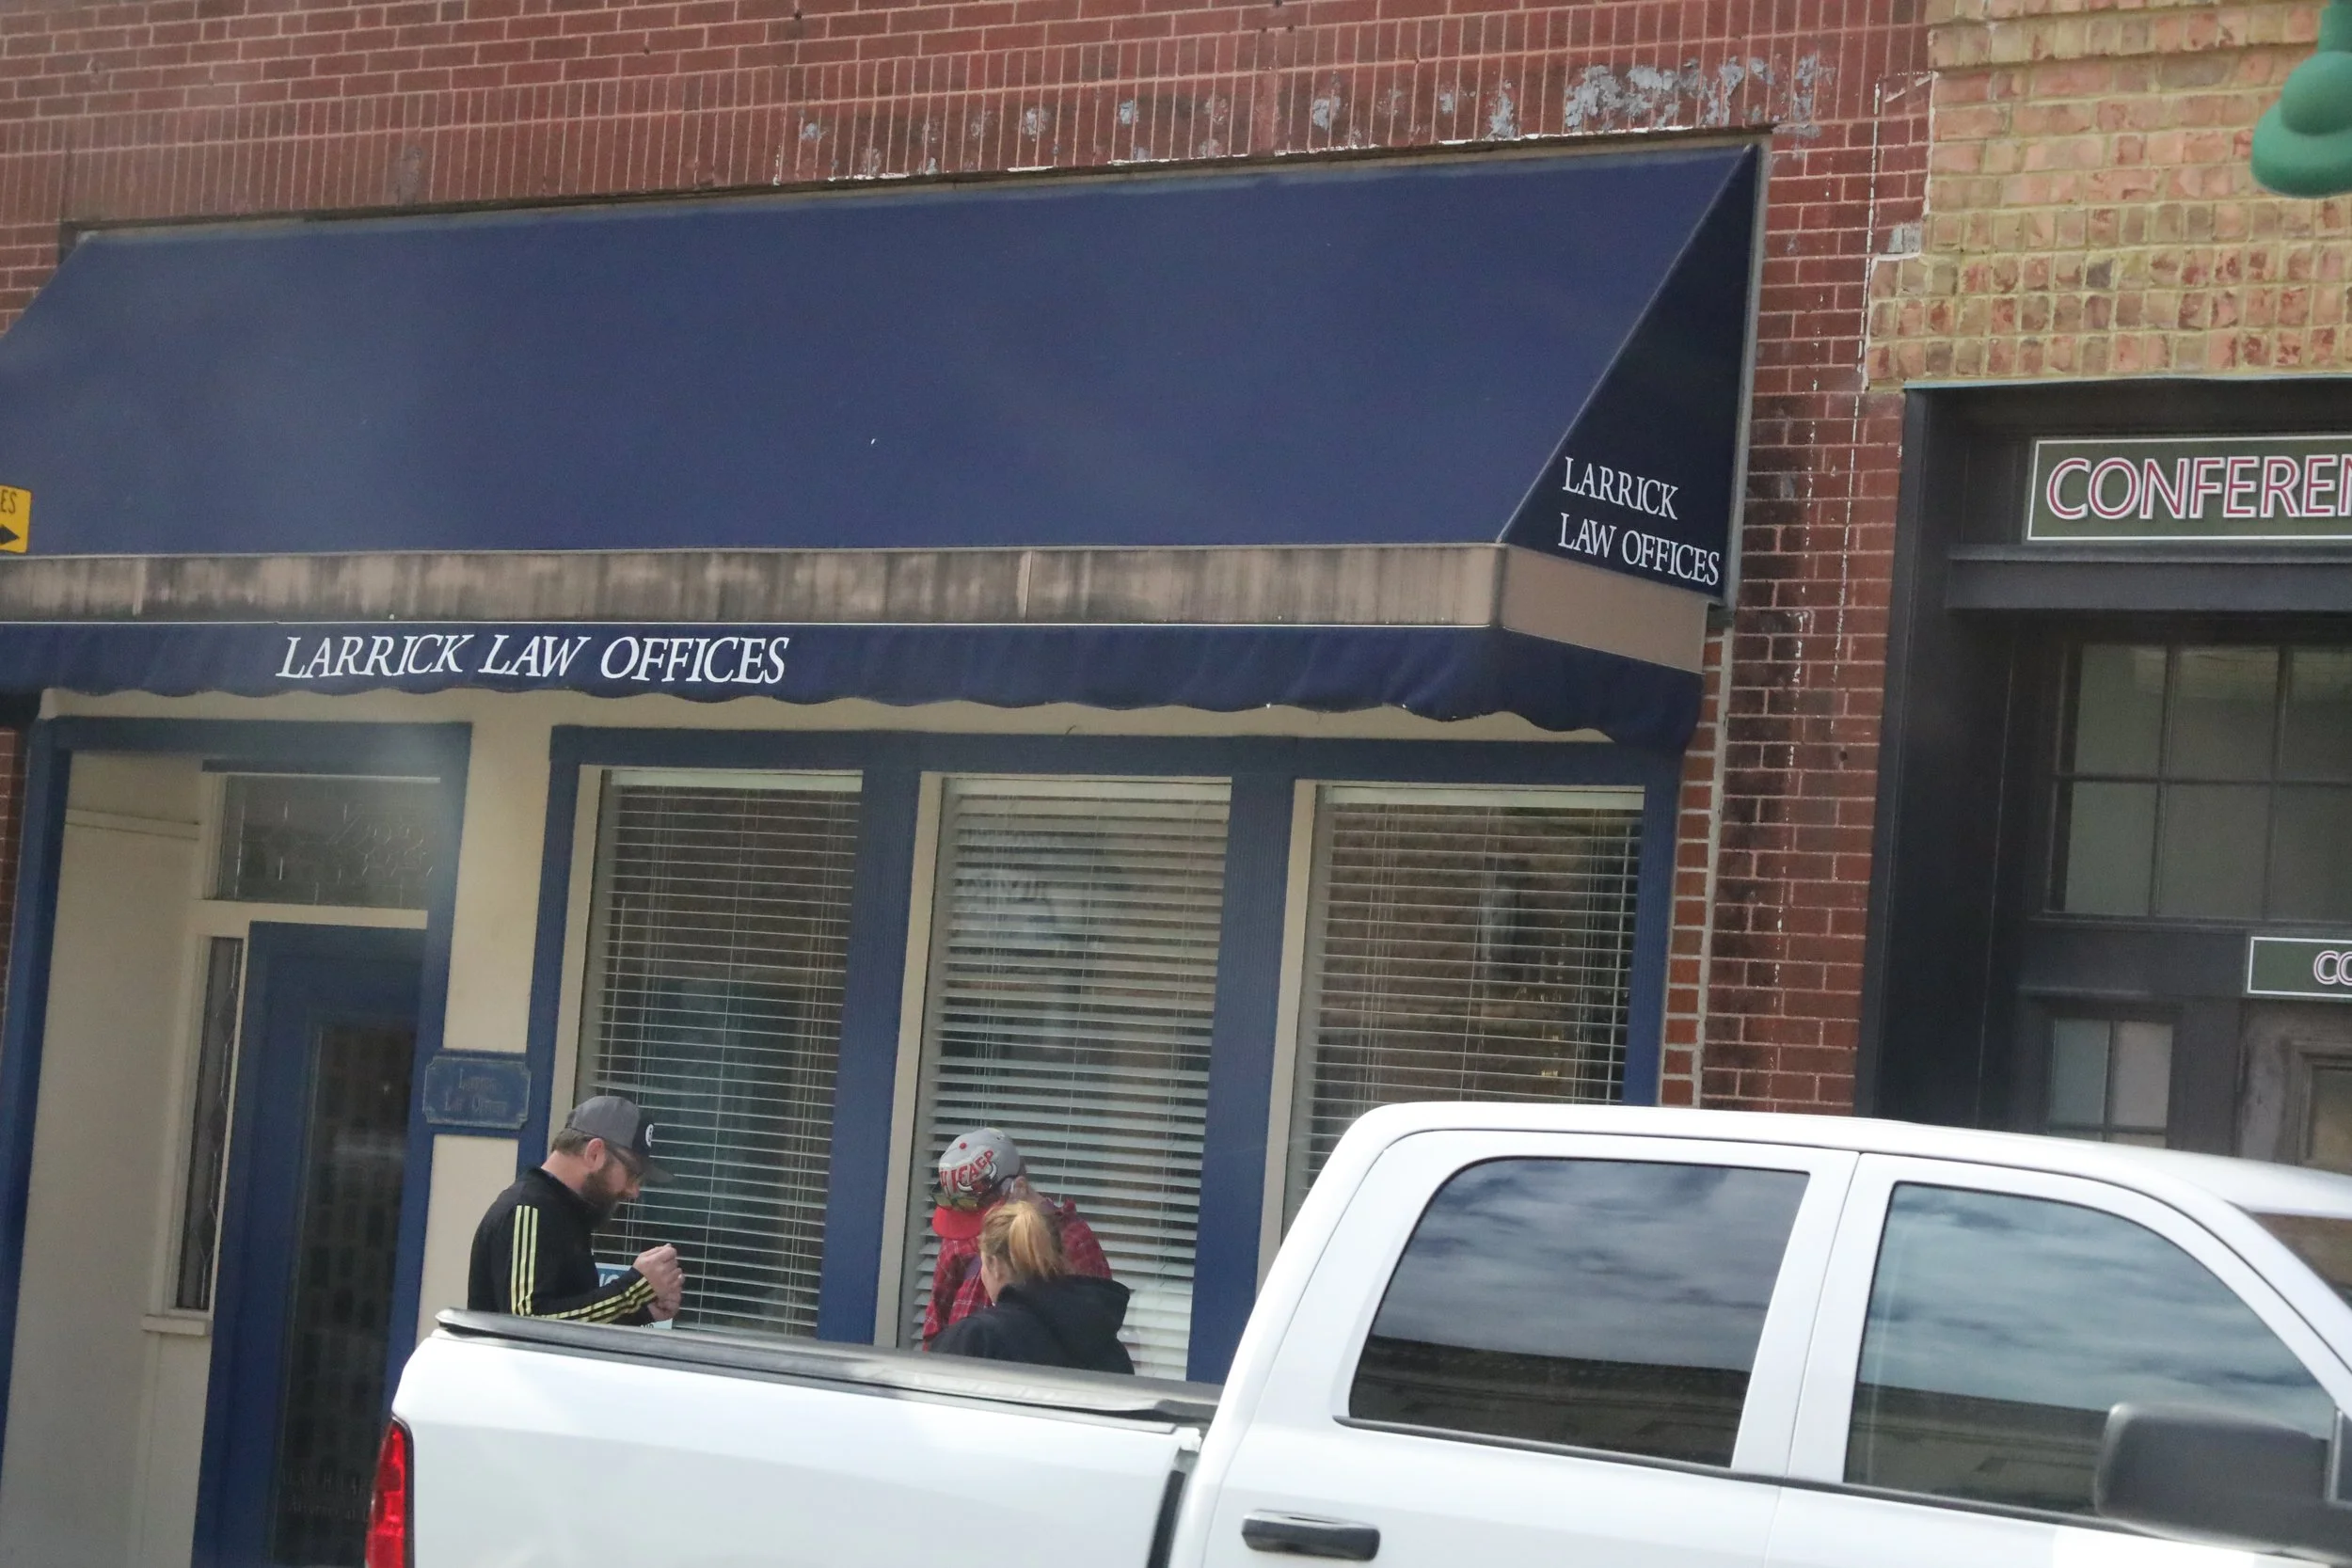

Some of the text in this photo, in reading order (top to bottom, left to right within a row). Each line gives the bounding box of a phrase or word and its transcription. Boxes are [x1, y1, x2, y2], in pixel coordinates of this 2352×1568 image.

[1563, 457, 1678, 520] LARRICK
[1558, 513, 1720, 585] LAW OFFICES
[276, 634, 789, 684] LARRICK LAW OFFICES
